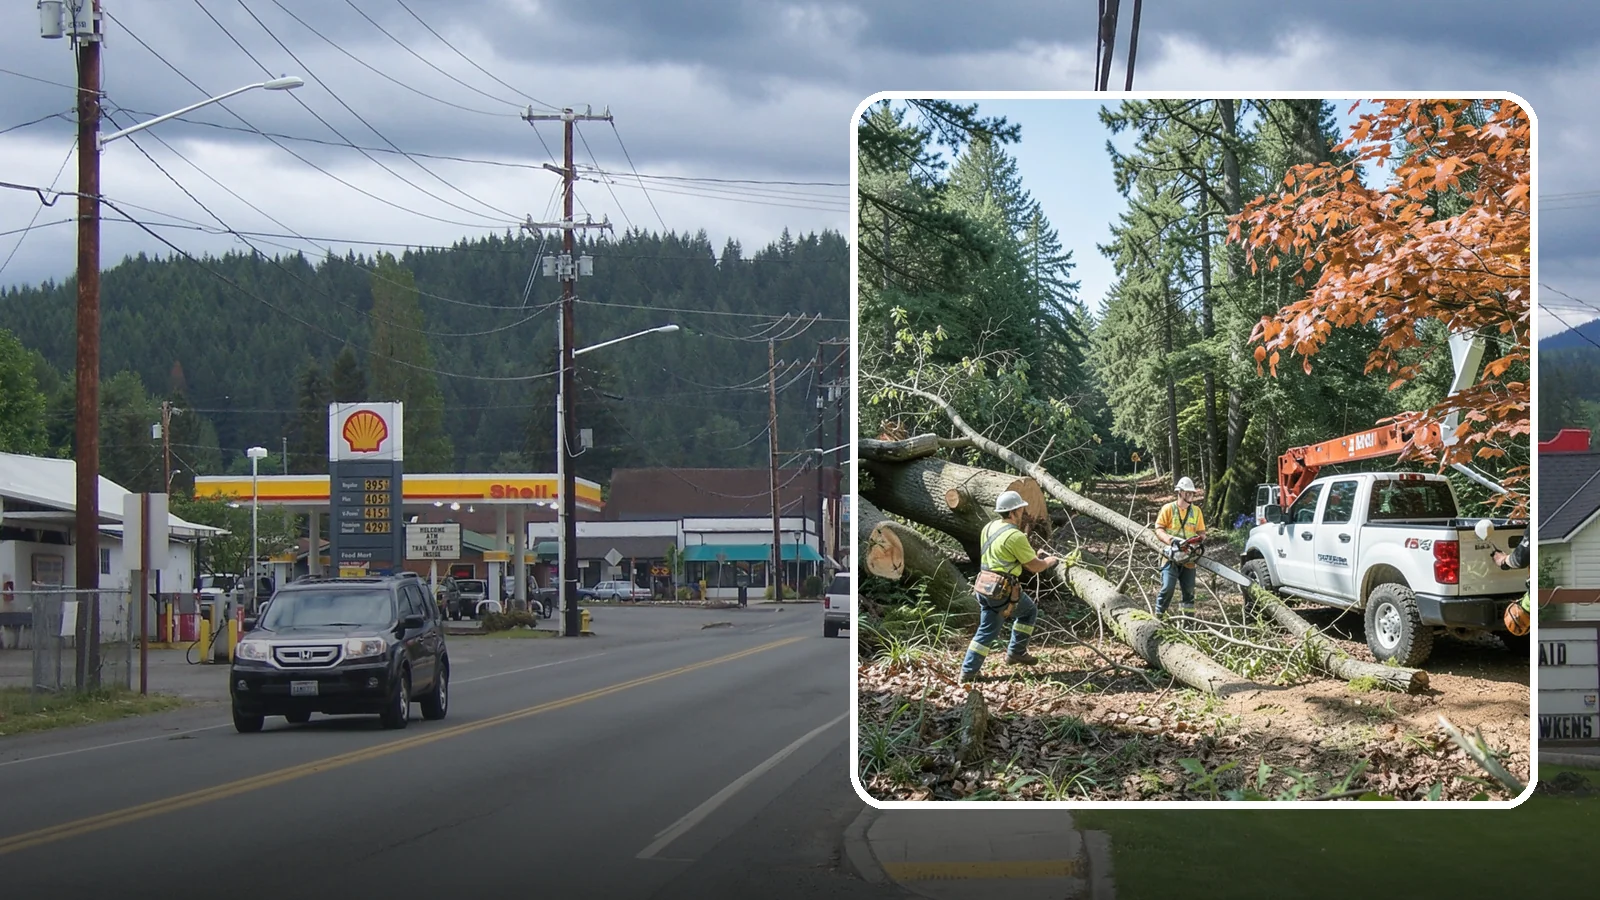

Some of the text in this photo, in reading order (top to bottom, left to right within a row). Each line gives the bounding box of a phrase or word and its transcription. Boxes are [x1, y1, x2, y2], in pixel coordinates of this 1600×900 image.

[365, 480, 384, 490] 395
[490, 484, 548, 499] Shell
[365, 494, 384, 504] 405
[365, 508, 384, 518] 415
[365, 522, 384, 532] 429
